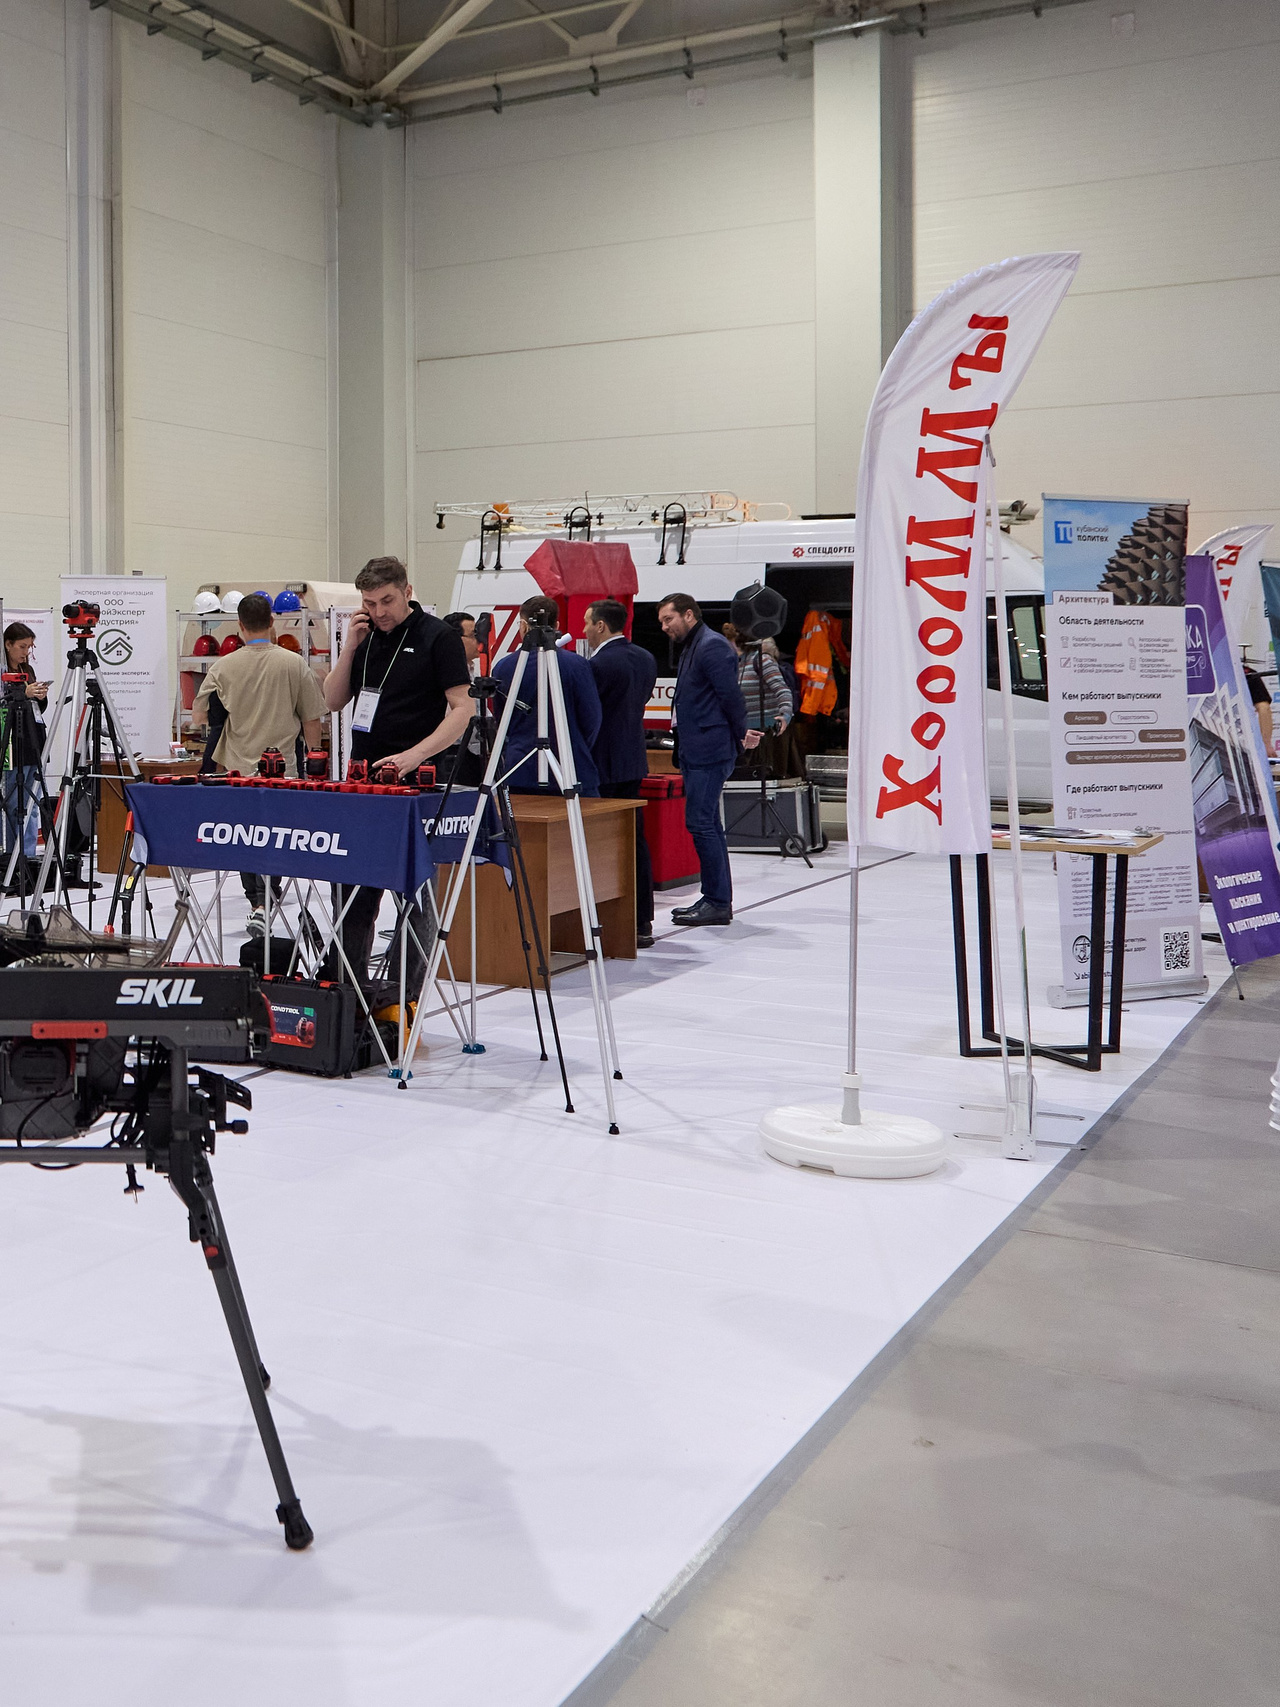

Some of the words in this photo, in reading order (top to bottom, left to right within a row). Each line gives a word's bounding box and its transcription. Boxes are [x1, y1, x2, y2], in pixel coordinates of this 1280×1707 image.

[1076, 524, 1109, 533] кубанский
[1077, 534, 1108, 542] политех
[1059, 594, 1109, 604] Архитектура
[1059, 616, 1092, 625] Область
[1093, 617, 1144, 626] деятельности
[1062, 692, 1079, 700] Кем
[1081, 692, 1115, 701] работают
[1117, 692, 1161, 701] выпускники
[1066, 785, 1081, 794] Где
[1083, 785, 1117, 794] работают
[1119, 784, 1163, 794] выпускники
[197, 822, 348, 856] CONDTROL
[116, 979, 204, 1008] SKIL
[271, 1005, 300, 1015] CONDTROL
